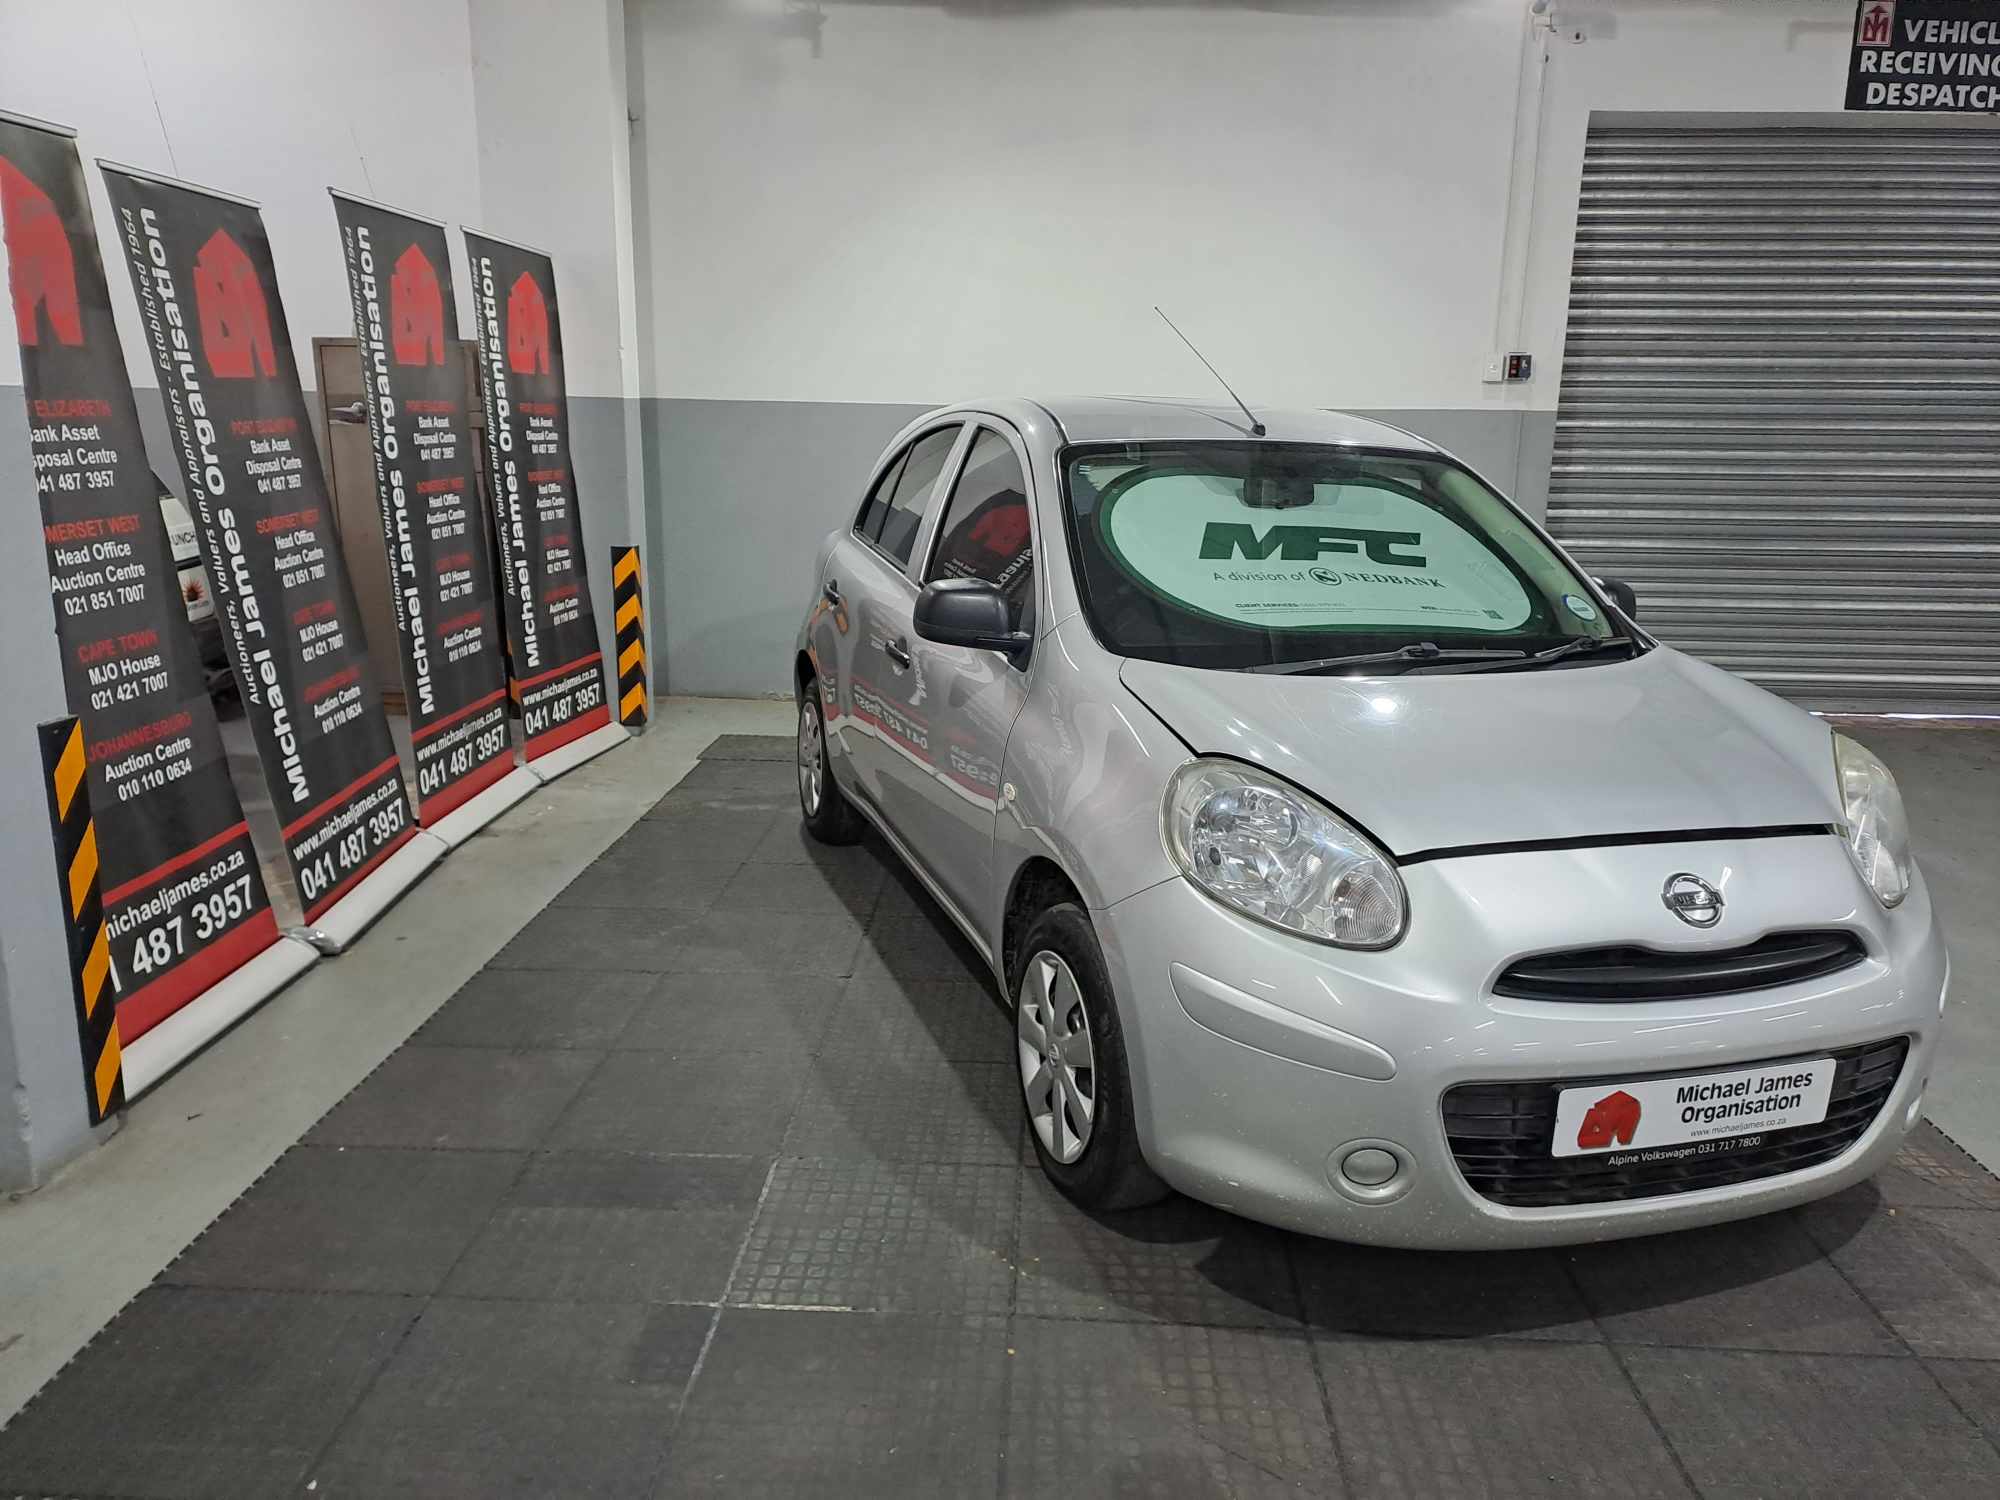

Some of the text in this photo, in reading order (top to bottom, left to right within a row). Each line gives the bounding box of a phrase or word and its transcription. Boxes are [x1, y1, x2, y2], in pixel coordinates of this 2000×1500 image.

[1904, 20, 2000, 45] VEHICL
[121, 207, 143, 256] 1964
[134, 260, 172, 371] Established
[30, 423, 101, 443] ank Asset
[168, 388, 201, 485] Appraisers
[77, 447, 118, 465] Centre
[357, 226, 435, 715] Michael James Organisation
[481, 256, 540, 668] Michael James Organisation
[36, 470, 114, 493] 41 487 3957
[140, 207, 310, 803] Michael James Organisation
[192, 488, 212, 524] and
[55, 541, 132, 566] Head Office
[206, 528, 230, 594] Valuers
[1199, 521, 1426, 568] MFC
[51, 562, 146, 593] Auction Centre
[1213, 571, 1447, 589] A division of NEDBANK
[64, 584, 145, 616] 021 851 7007
[88, 654, 161, 686] MJO House
[91, 671, 168, 710] 021 421 7007
[525, 682, 600, 735] 041 487 3957
[104, 737, 191, 784] Auction Centre
[118, 757, 192, 801] 010 110 0634
[420, 724, 504, 795] 041 487 3957
[293, 778, 398, 861] www.michaeljames.co.za
[301, 797, 404, 900] 041 487 3957
[132, 915, 184, 974] 487
[191, 873, 252, 940] 3957
[1676, 1072, 1813, 1104] Michael James
[1680, 1092, 1801, 1124] Organisation
[1608, 1136, 1761, 1166] Alpine Volkswagen 031 717 7800
